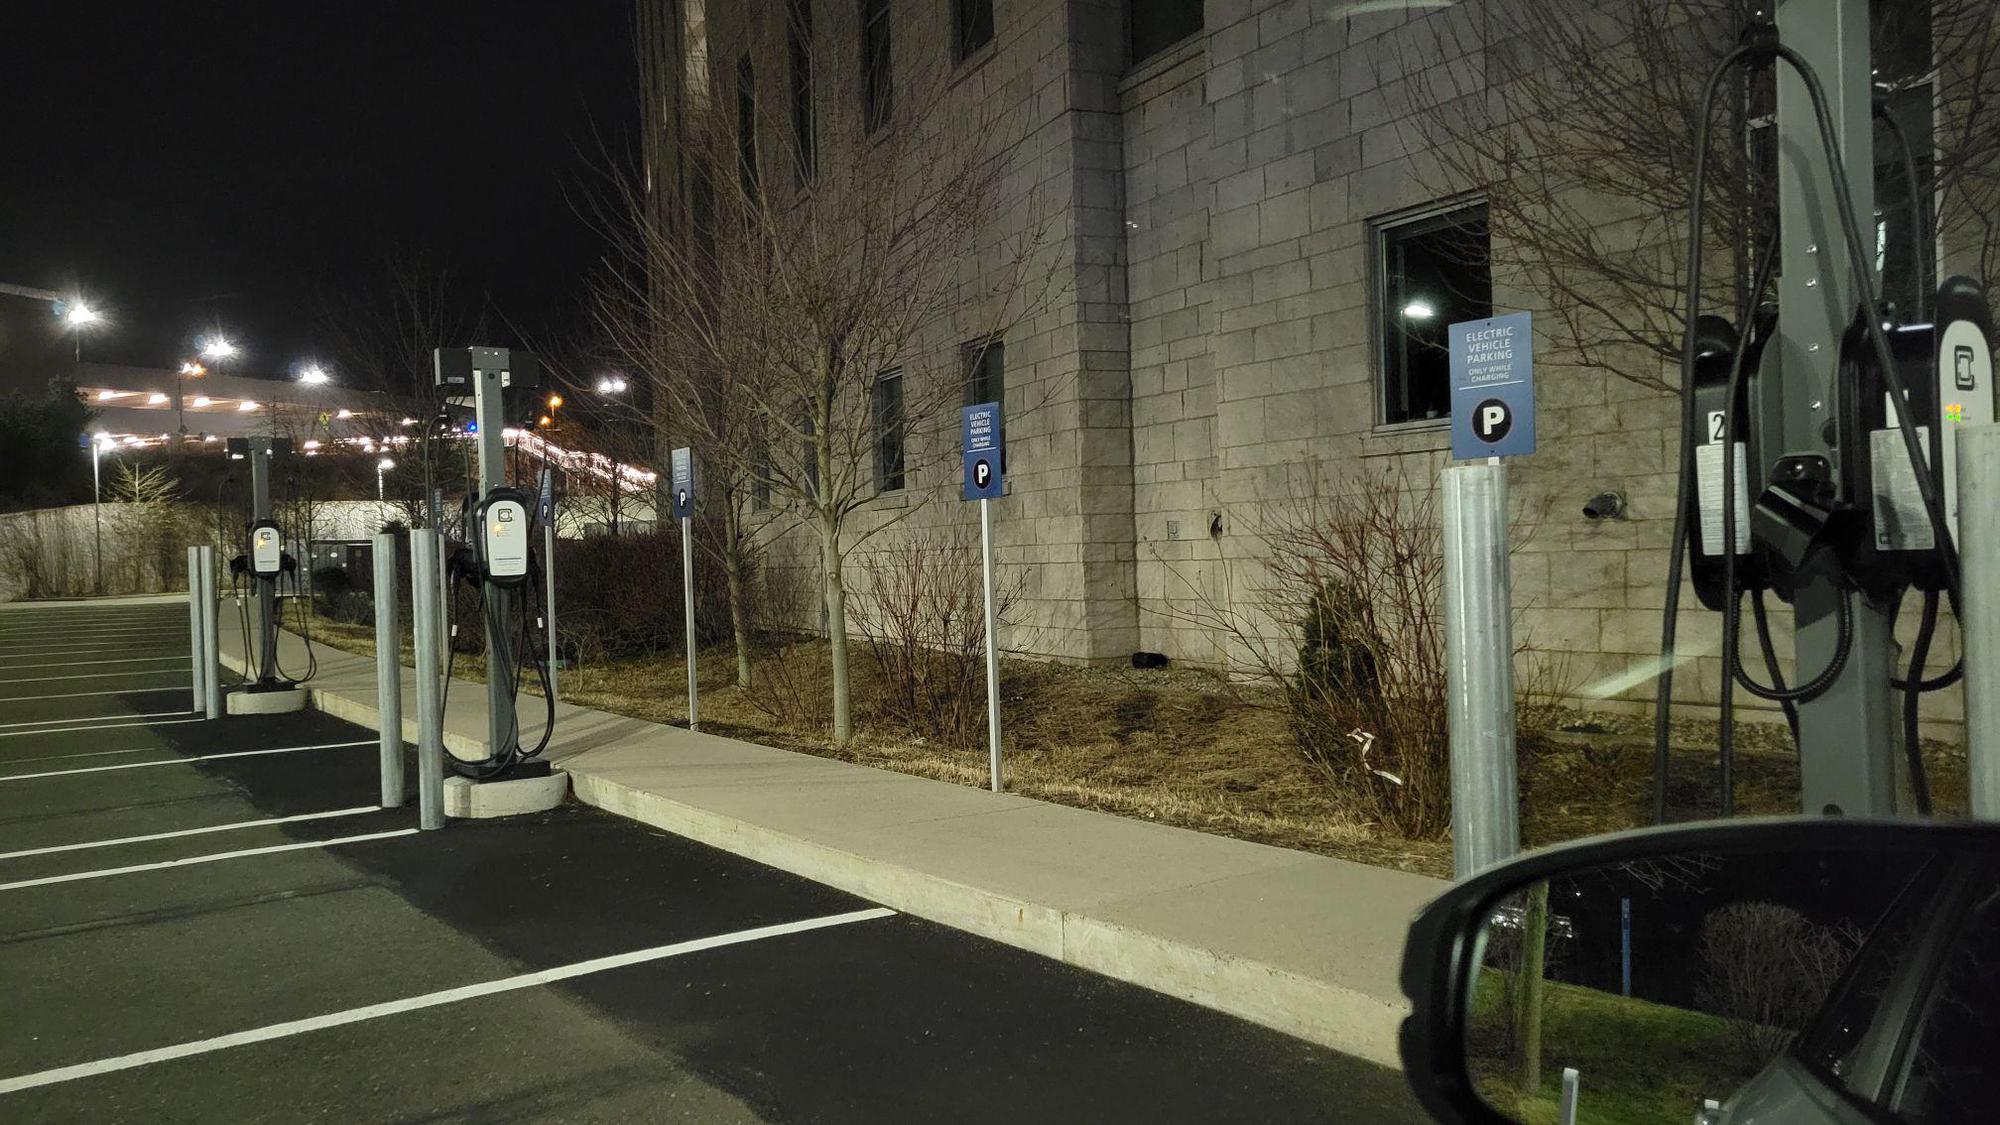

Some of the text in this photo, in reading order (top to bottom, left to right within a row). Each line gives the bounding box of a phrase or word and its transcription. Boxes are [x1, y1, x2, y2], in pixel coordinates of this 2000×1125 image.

[1466, 327, 1513, 342] ELECTRIC
[1469, 339, 1511, 353] VEHICLE
[1467, 350, 1513, 364] PARKING
[1468, 363, 1512, 376] ONLY WHILE
[1471, 372, 1510, 383] CHARGING
[969, 411, 991, 420] ELECTRIC
[1483, 406, 1505, 435] P
[970, 418, 990, 428] VEHICLE
[1713, 413, 1725, 440] 2
[970, 426, 991, 435] PARKING
[977, 464, 989, 484] P
[680, 491, 686, 507] P
